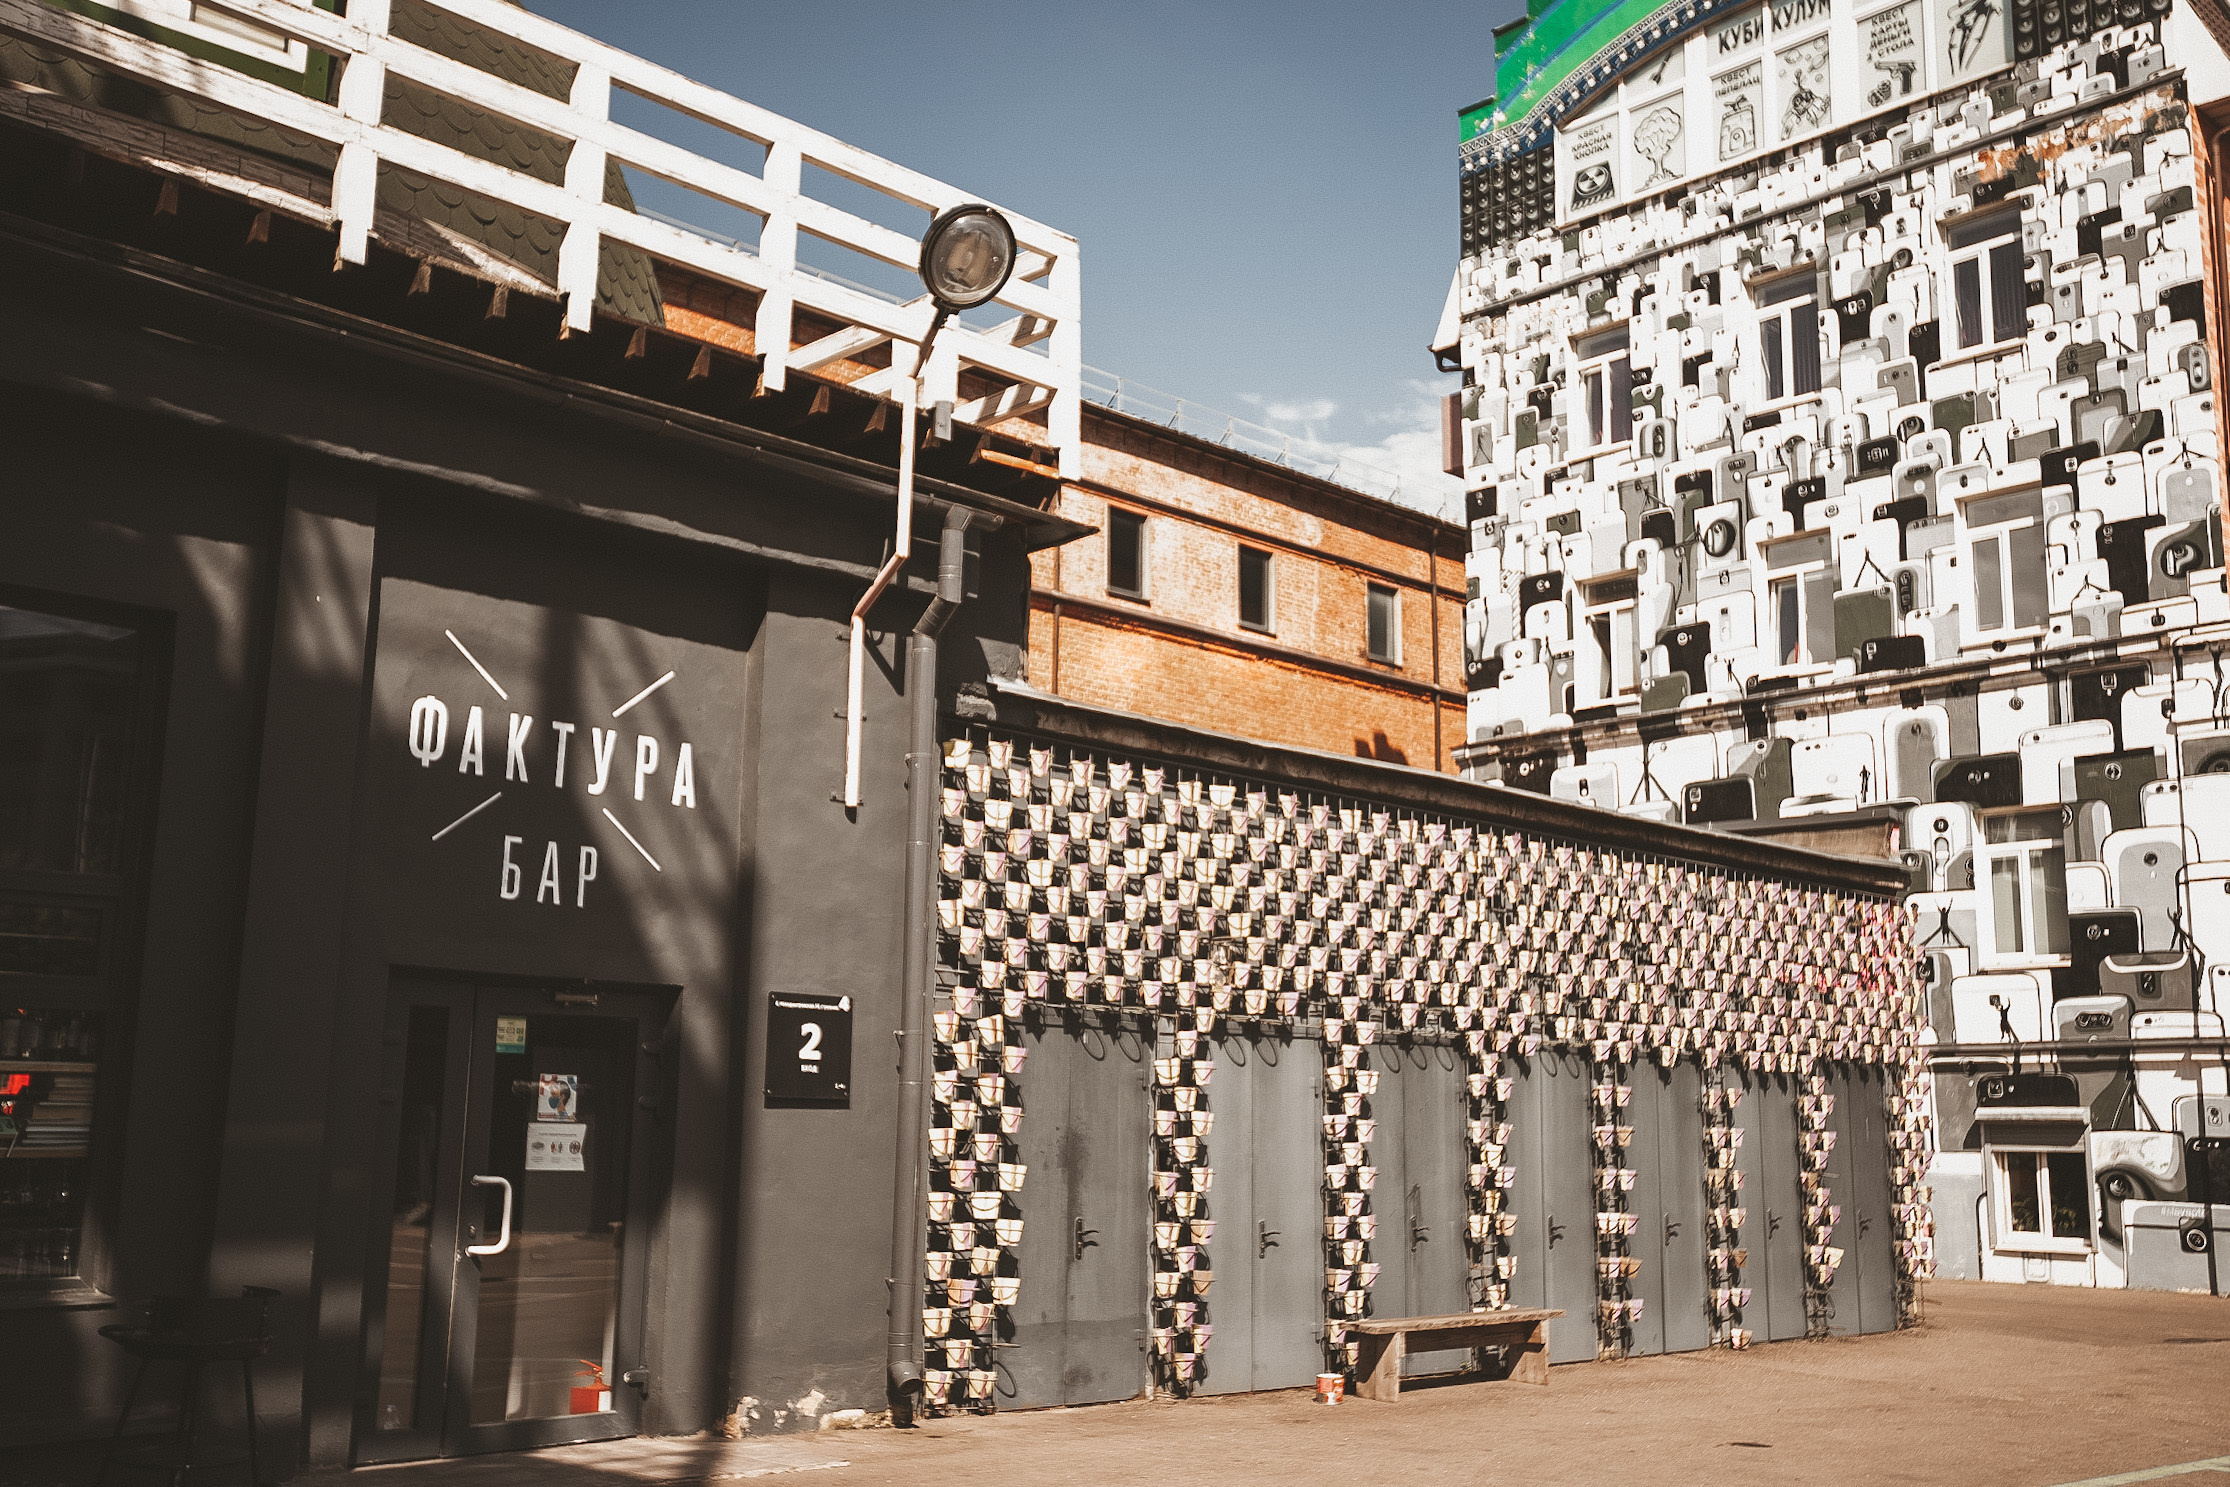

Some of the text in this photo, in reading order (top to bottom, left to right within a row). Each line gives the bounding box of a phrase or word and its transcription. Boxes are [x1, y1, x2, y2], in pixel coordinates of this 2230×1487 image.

[1872, 5, 1905, 26] КВЕСТ
[1871, 17, 1908, 38] КАРТЫ
[1870, 27, 1911, 51] ДЕНЬГИ
[1878, 38, 1914, 57] СТОЛА
[1715, 75, 1760, 98] ПЕПЕЛАЦ
[1720, 67, 1751, 85] КВЕСТ
[1571, 132, 1612, 152] КРАСНАЯ
[1578, 124, 1604, 140] КВЕСТ
[1574, 142, 1610, 160] КНОПКА
[409, 695, 697, 809] ФАКТУРА
[500, 835, 599, 908] БАР
[799, 1022, 822, 1060] 2
